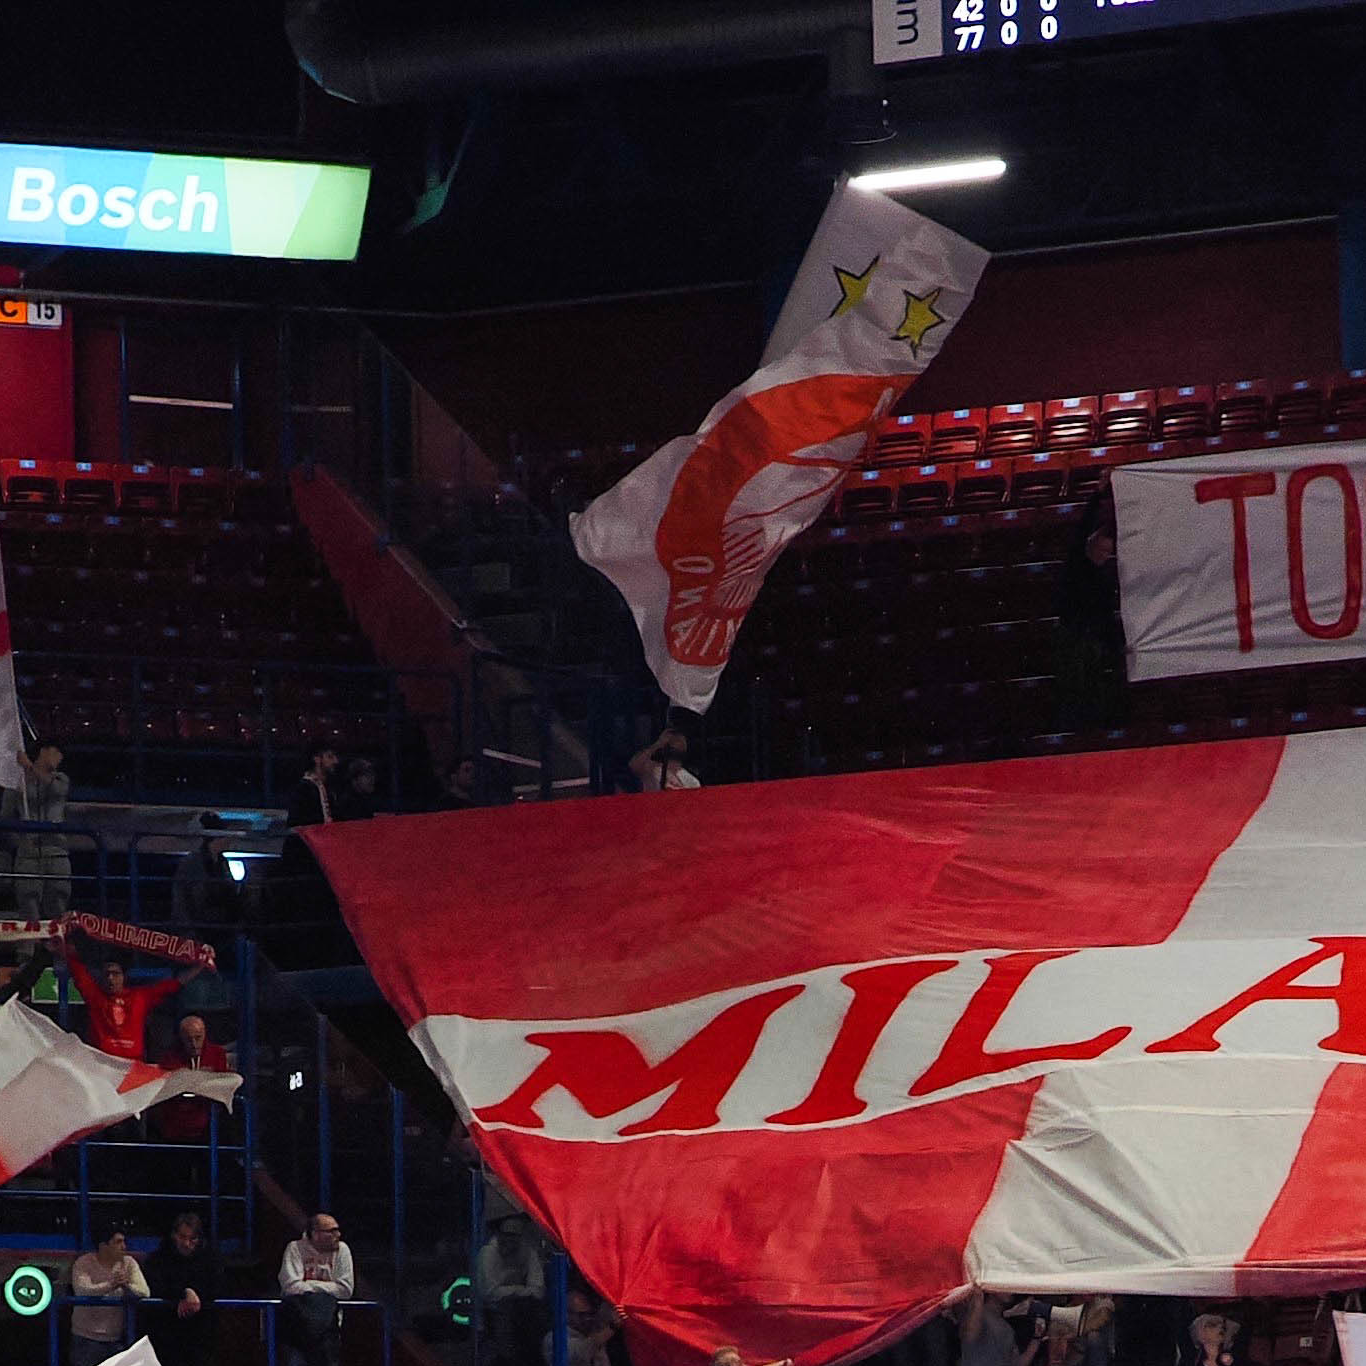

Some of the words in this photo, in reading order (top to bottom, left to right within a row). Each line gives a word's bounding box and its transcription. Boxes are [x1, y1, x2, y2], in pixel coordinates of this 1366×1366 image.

[954, 24, 985, 51] 77
[1000, 20, 1018, 45] 0
[1040, 14, 1058, 40] 0
[8, 167, 217, 233] Bosch
[36, 303, 56, 320] 15
[80, 913, 197, 957] OLIMPIA
